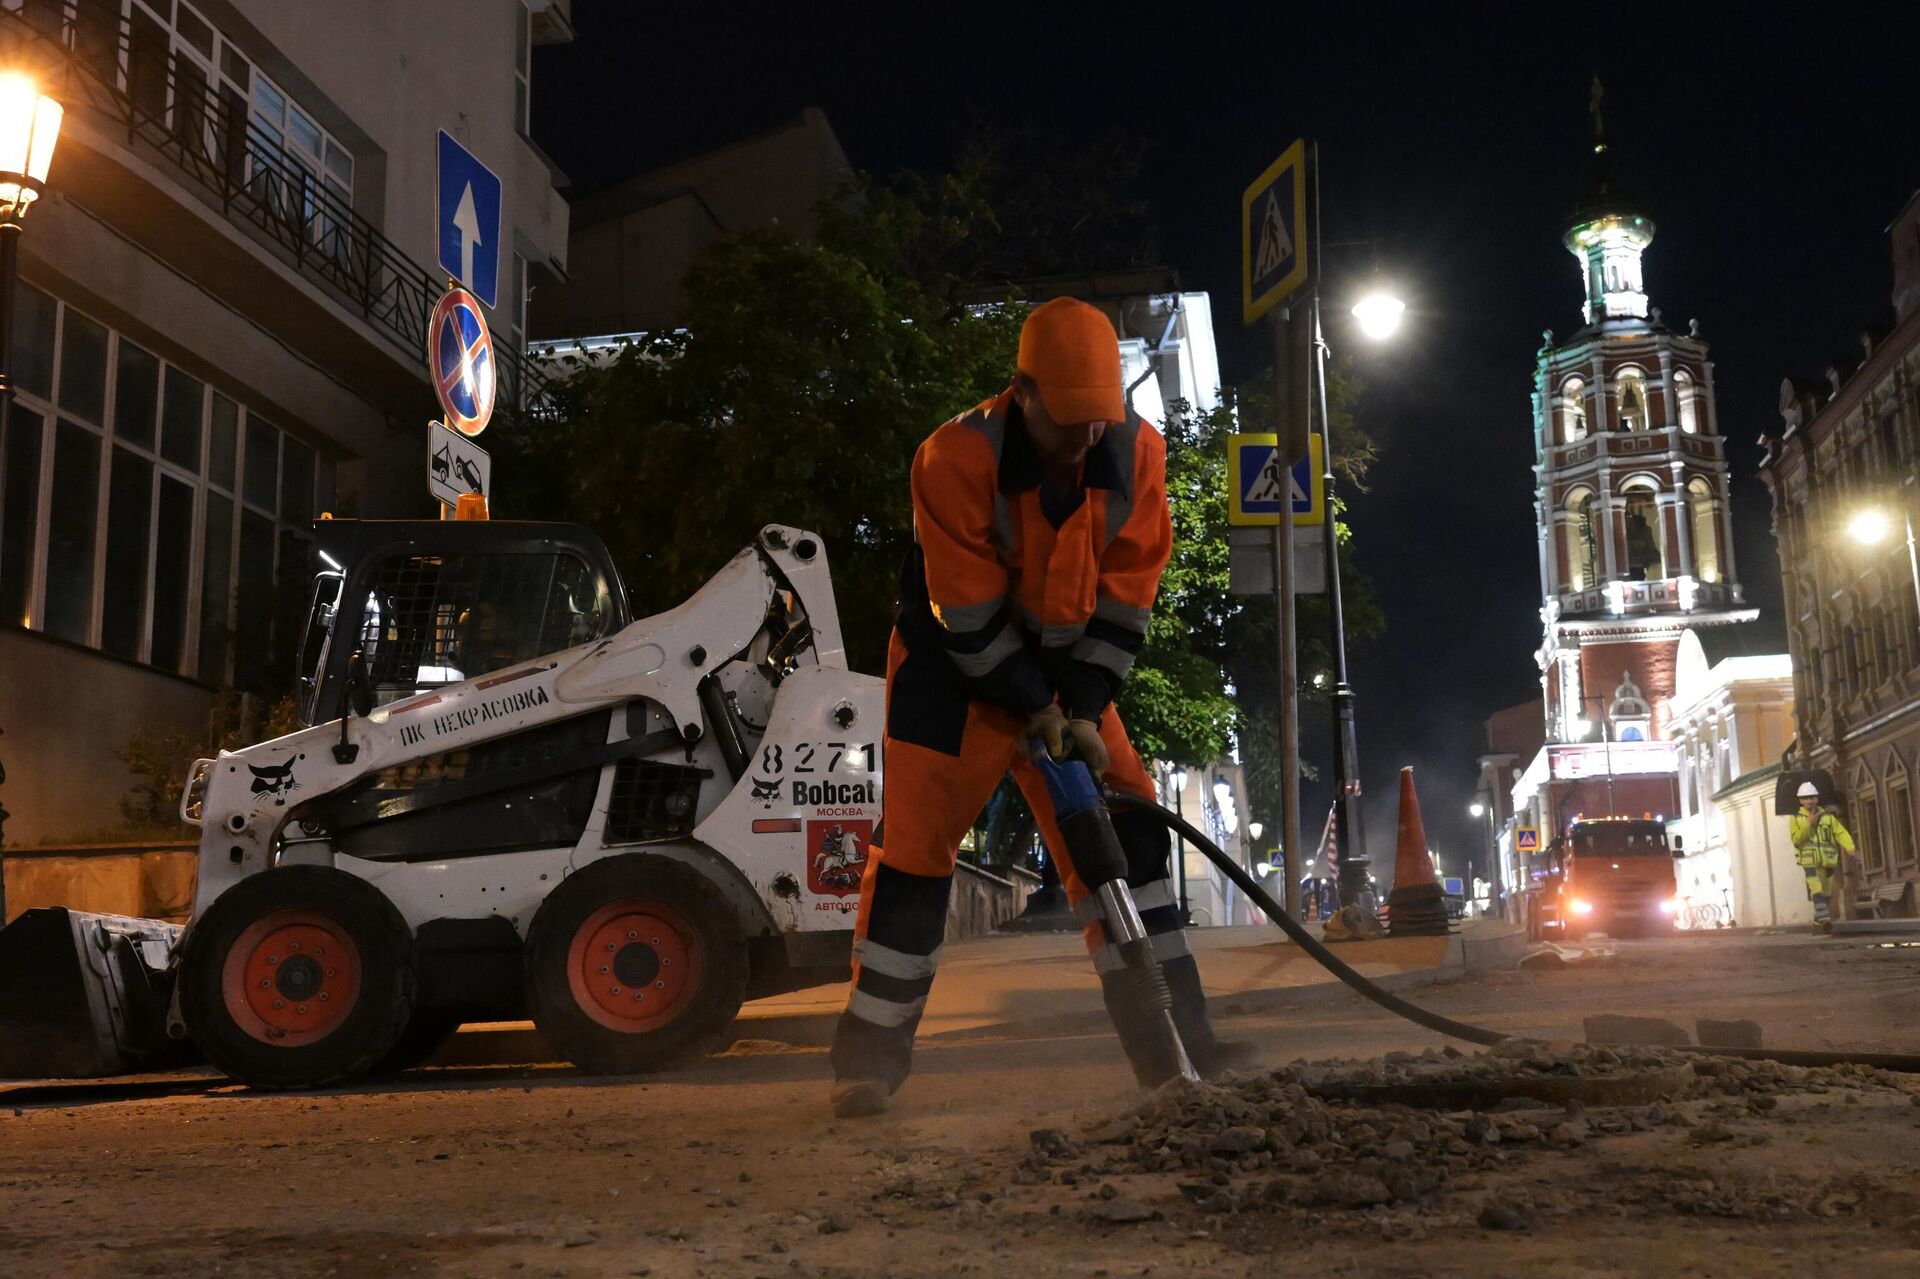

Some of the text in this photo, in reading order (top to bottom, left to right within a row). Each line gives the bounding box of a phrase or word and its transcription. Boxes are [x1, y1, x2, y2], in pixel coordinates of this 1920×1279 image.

[400, 686, 549, 746] ПК НЕКРАСОВКА
[763, 743, 875, 773] 8271
[792, 780, 875, 805] Bobcat
[817, 807, 863, 816] МОСКВА
[815, 902, 859, 912] АВТОДО
